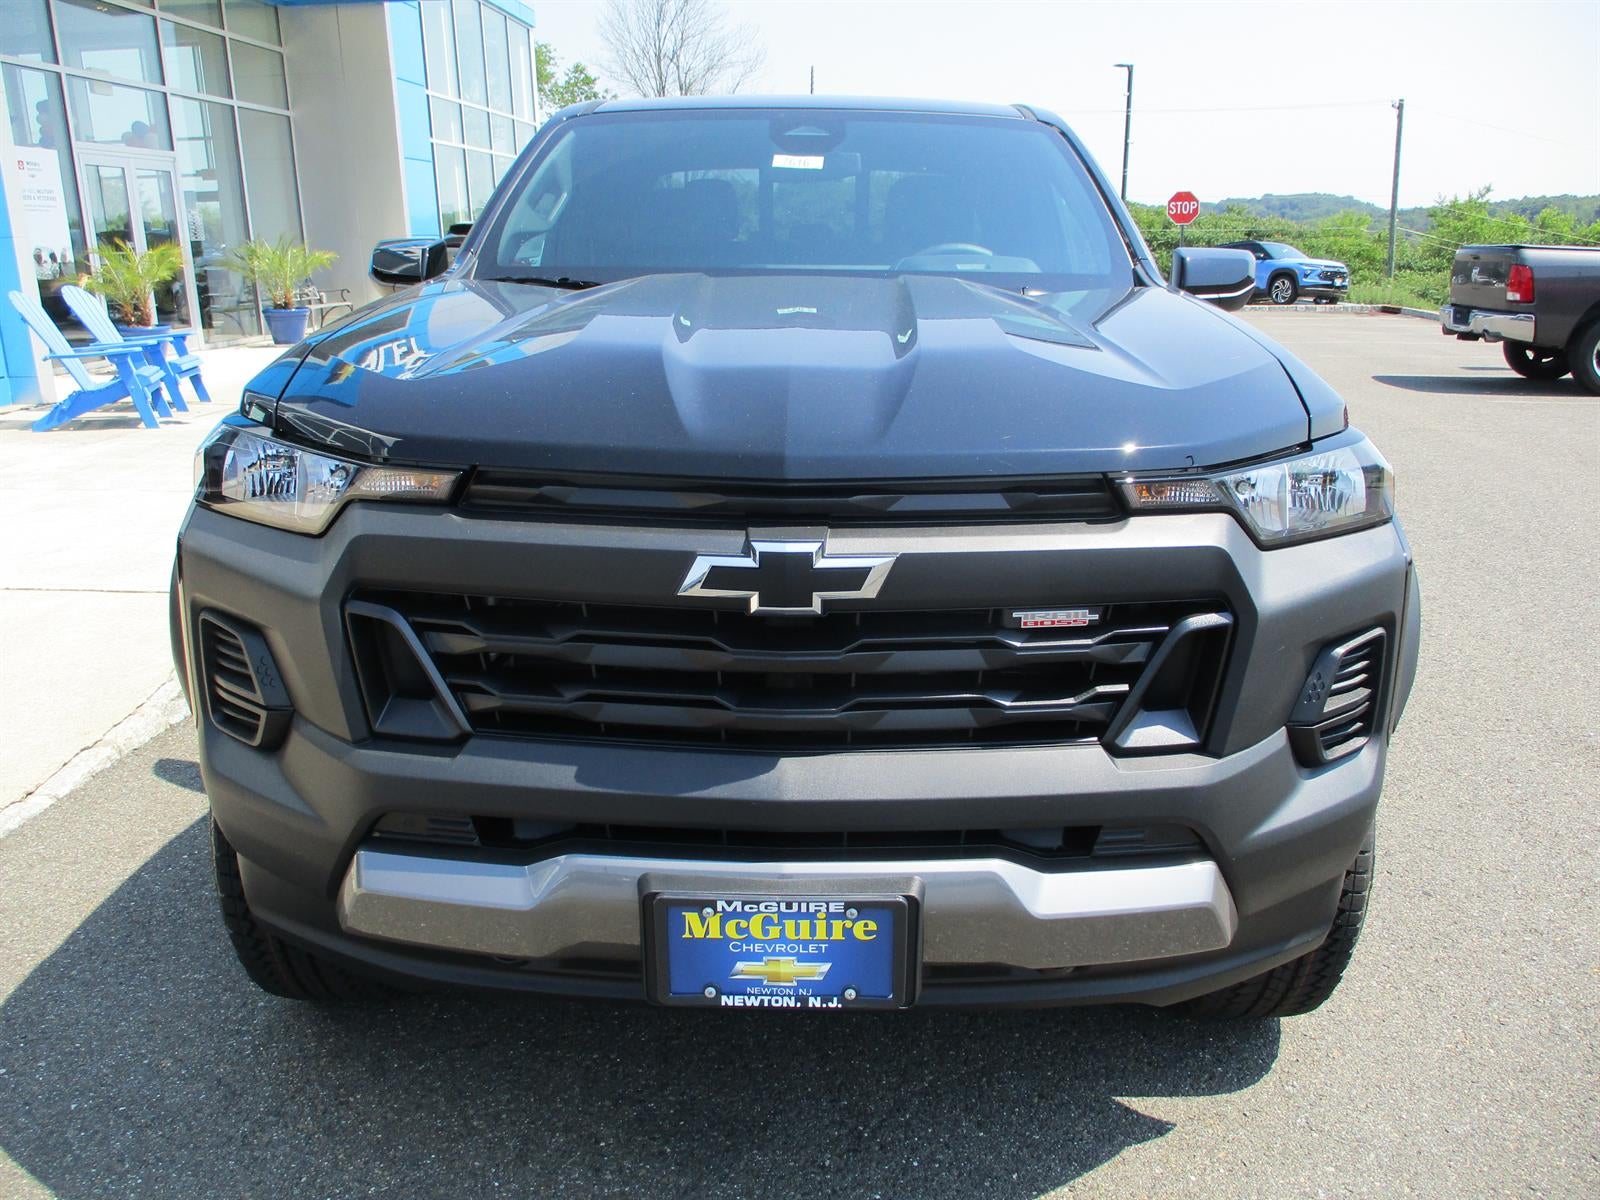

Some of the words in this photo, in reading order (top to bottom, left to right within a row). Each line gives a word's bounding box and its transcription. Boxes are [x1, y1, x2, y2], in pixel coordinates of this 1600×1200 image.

[1169, 201, 1198, 215] STOP
[717, 900, 844, 913] McGUIRE
[681, 911, 878, 941] McGuire
[729, 941, 829, 954] CHEVROLET
[799, 988, 812, 996] NJ
[808, 996, 842, 1008] N.J.
